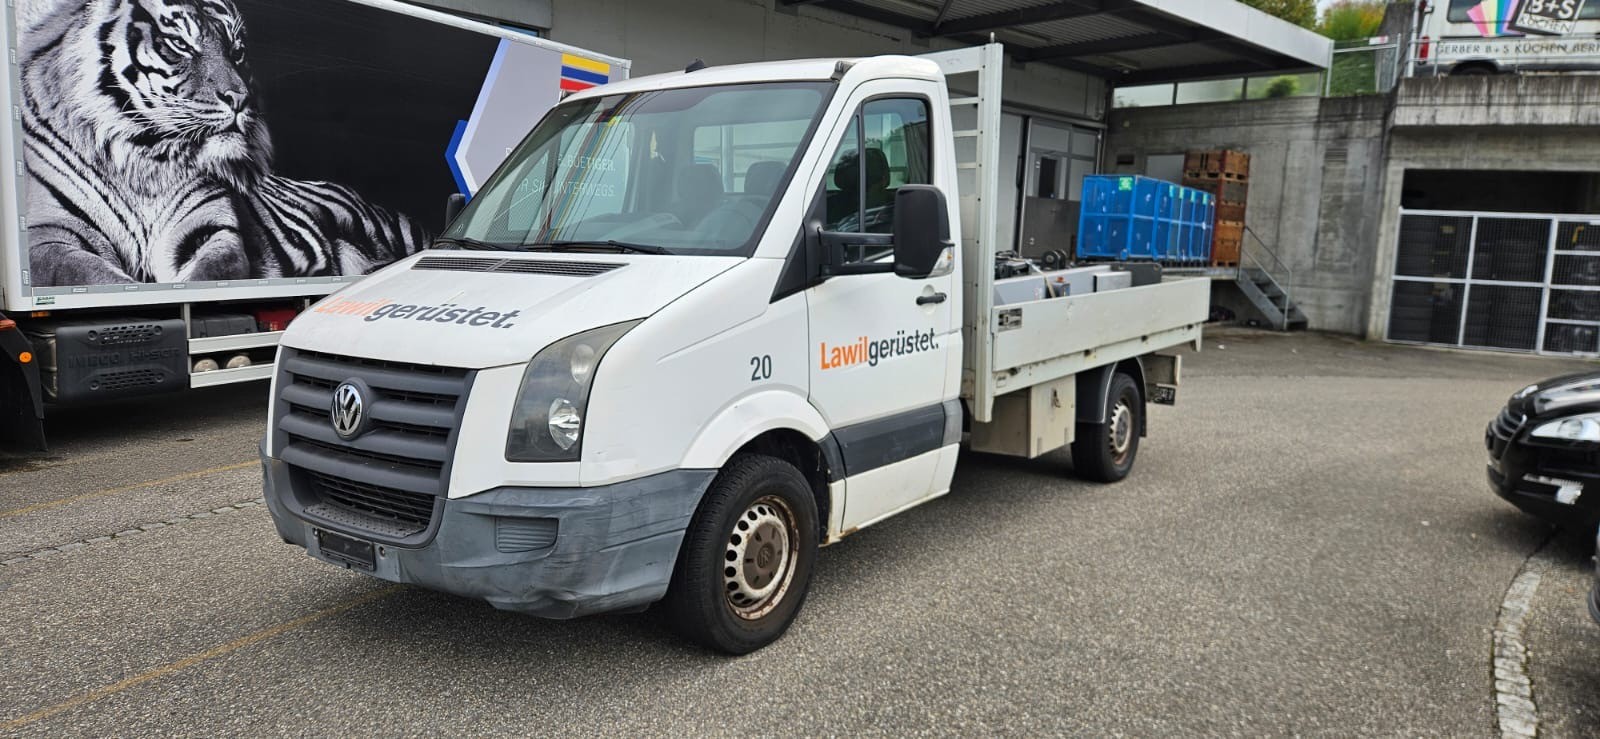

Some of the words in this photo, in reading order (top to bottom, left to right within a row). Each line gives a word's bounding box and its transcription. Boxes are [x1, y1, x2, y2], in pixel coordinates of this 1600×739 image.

[1529, 0, 1575, 19] B+S
[314, 295, 520, 329] Lawilgerüstet.
[820, 327, 939, 370] Lawilgerüstet.
[750, 354, 773, 382] 20
